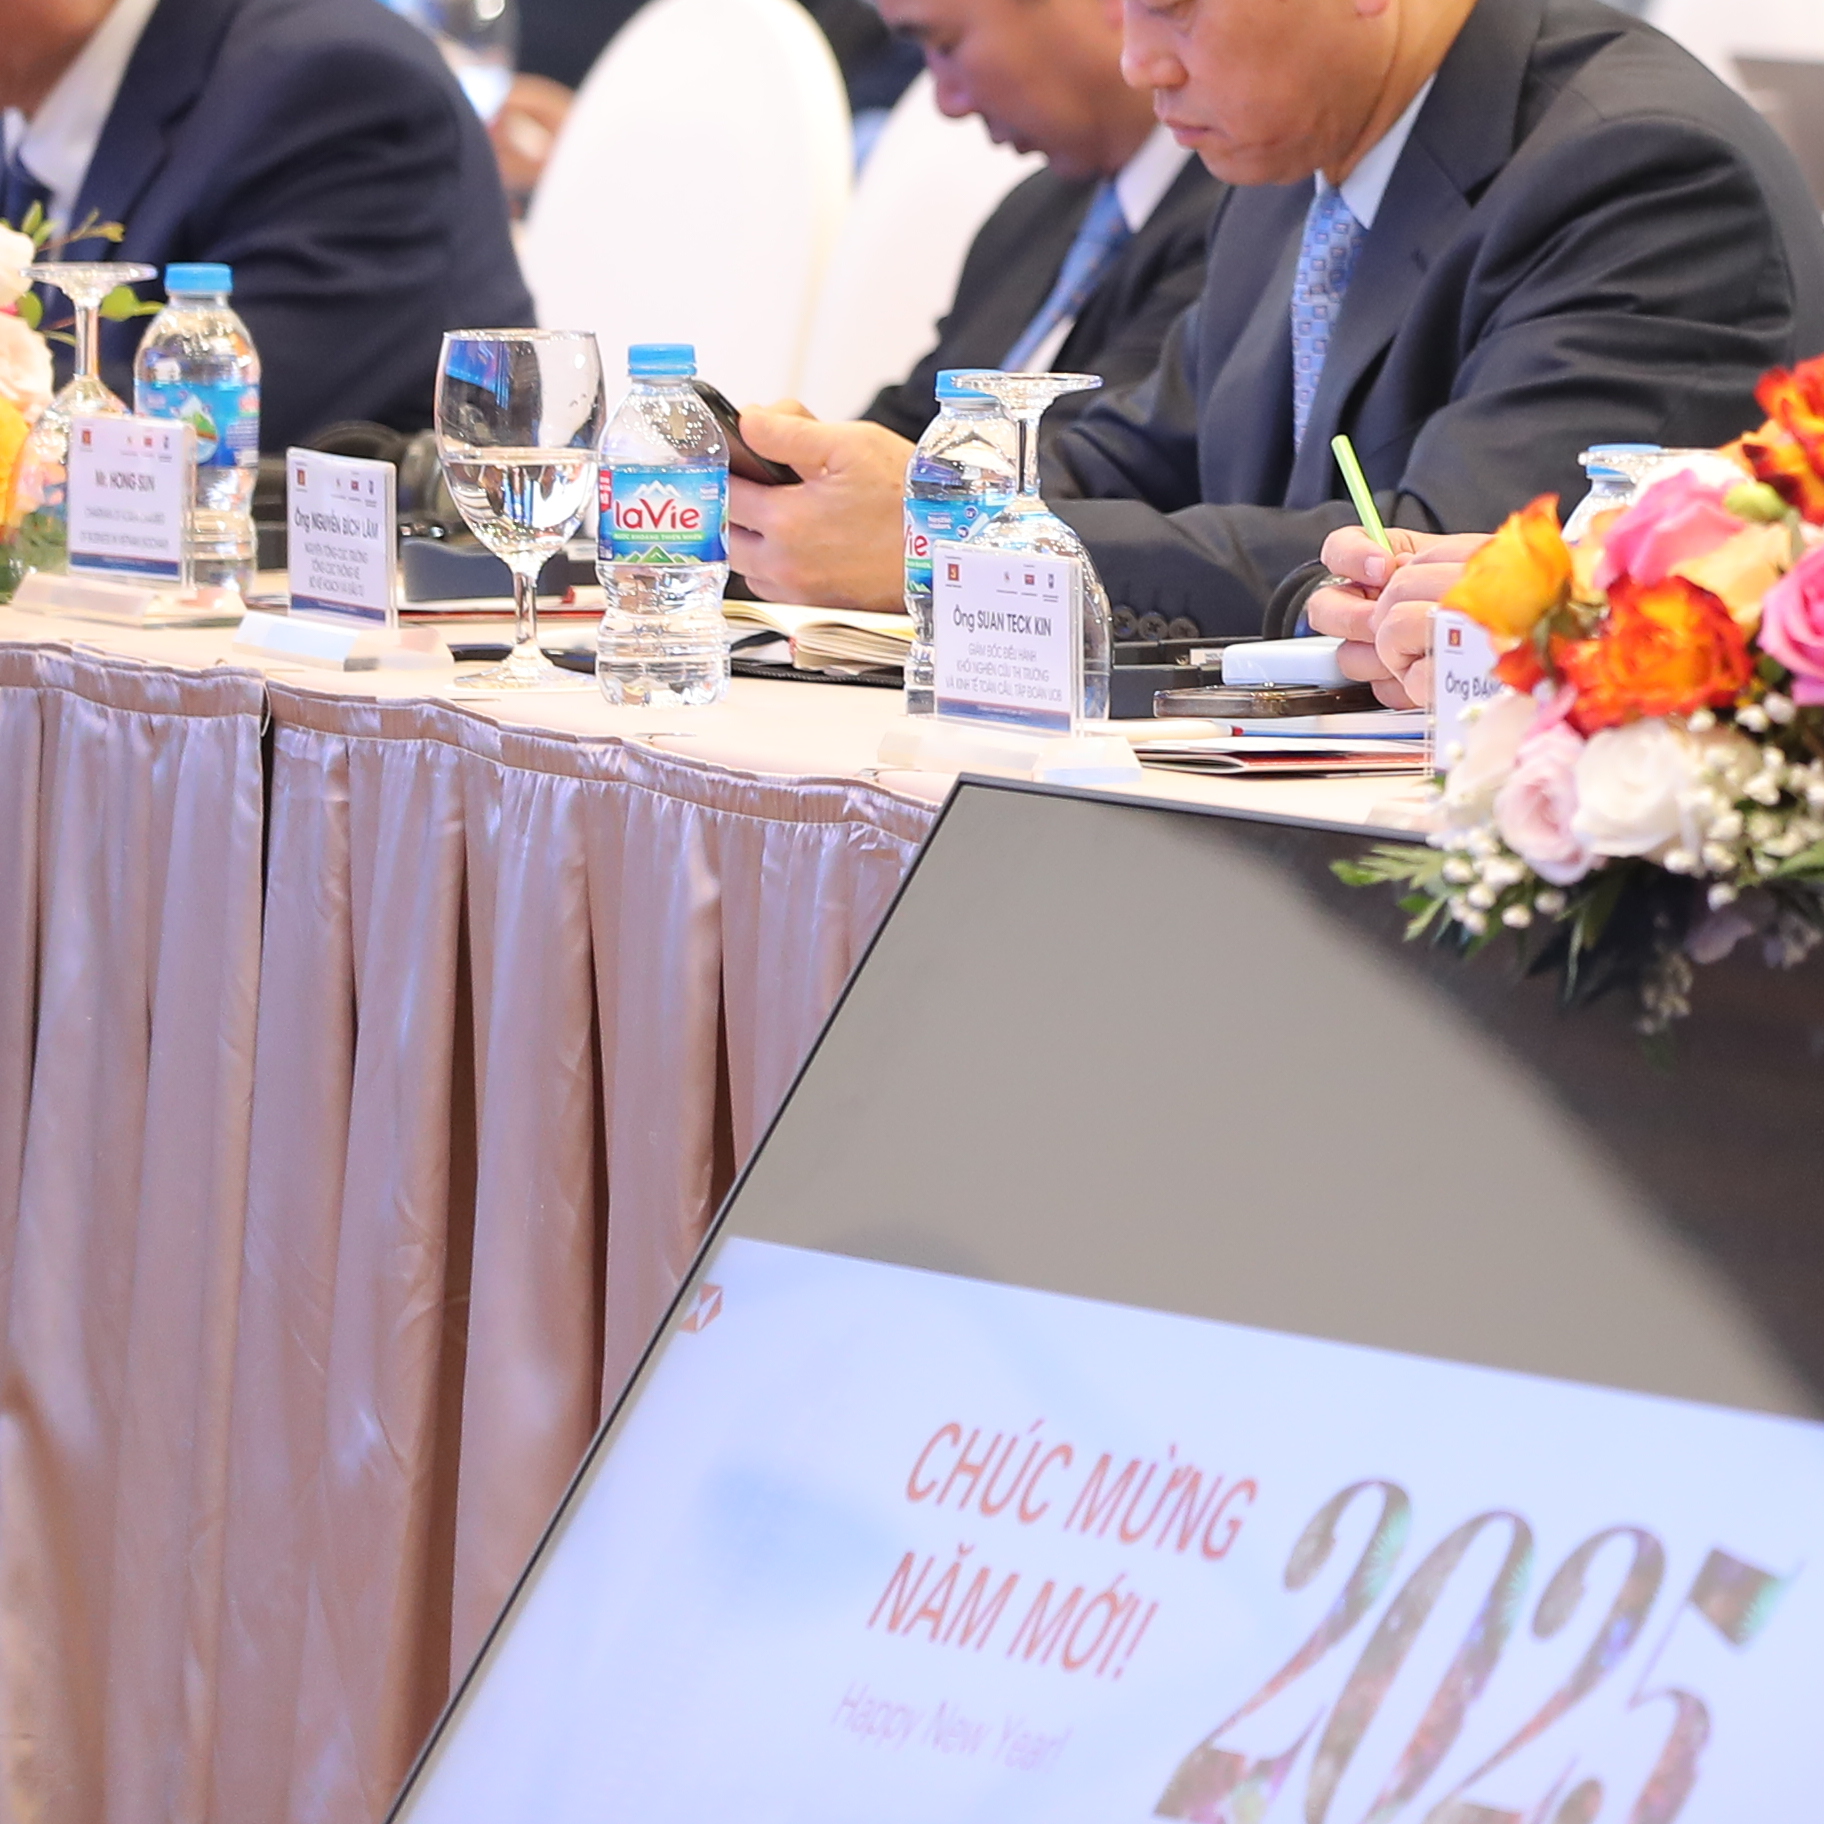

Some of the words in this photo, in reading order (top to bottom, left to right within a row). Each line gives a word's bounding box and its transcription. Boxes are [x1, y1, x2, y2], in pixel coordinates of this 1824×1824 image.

[614, 498, 700, 529] laVie
[953, 604, 975, 632] Ông
[977, 609, 1005, 632] SUAN
[1007, 613, 1032, 636] TECK
[1034, 616, 1052, 637] KIN
[1445, 671, 1470, 701] Ông
[907, 1417, 1074, 1524] CHÚC
[1063, 1441, 1258, 1561] MỪNG
[867, 1542, 1021, 1653] NĂM
[1005, 1572, 1159, 1681] MỚI!
[1152, 1478, 1802, 1823] 2025
[830, 1682, 926, 1750] Happy
[920, 1701, 992, 1756] New
